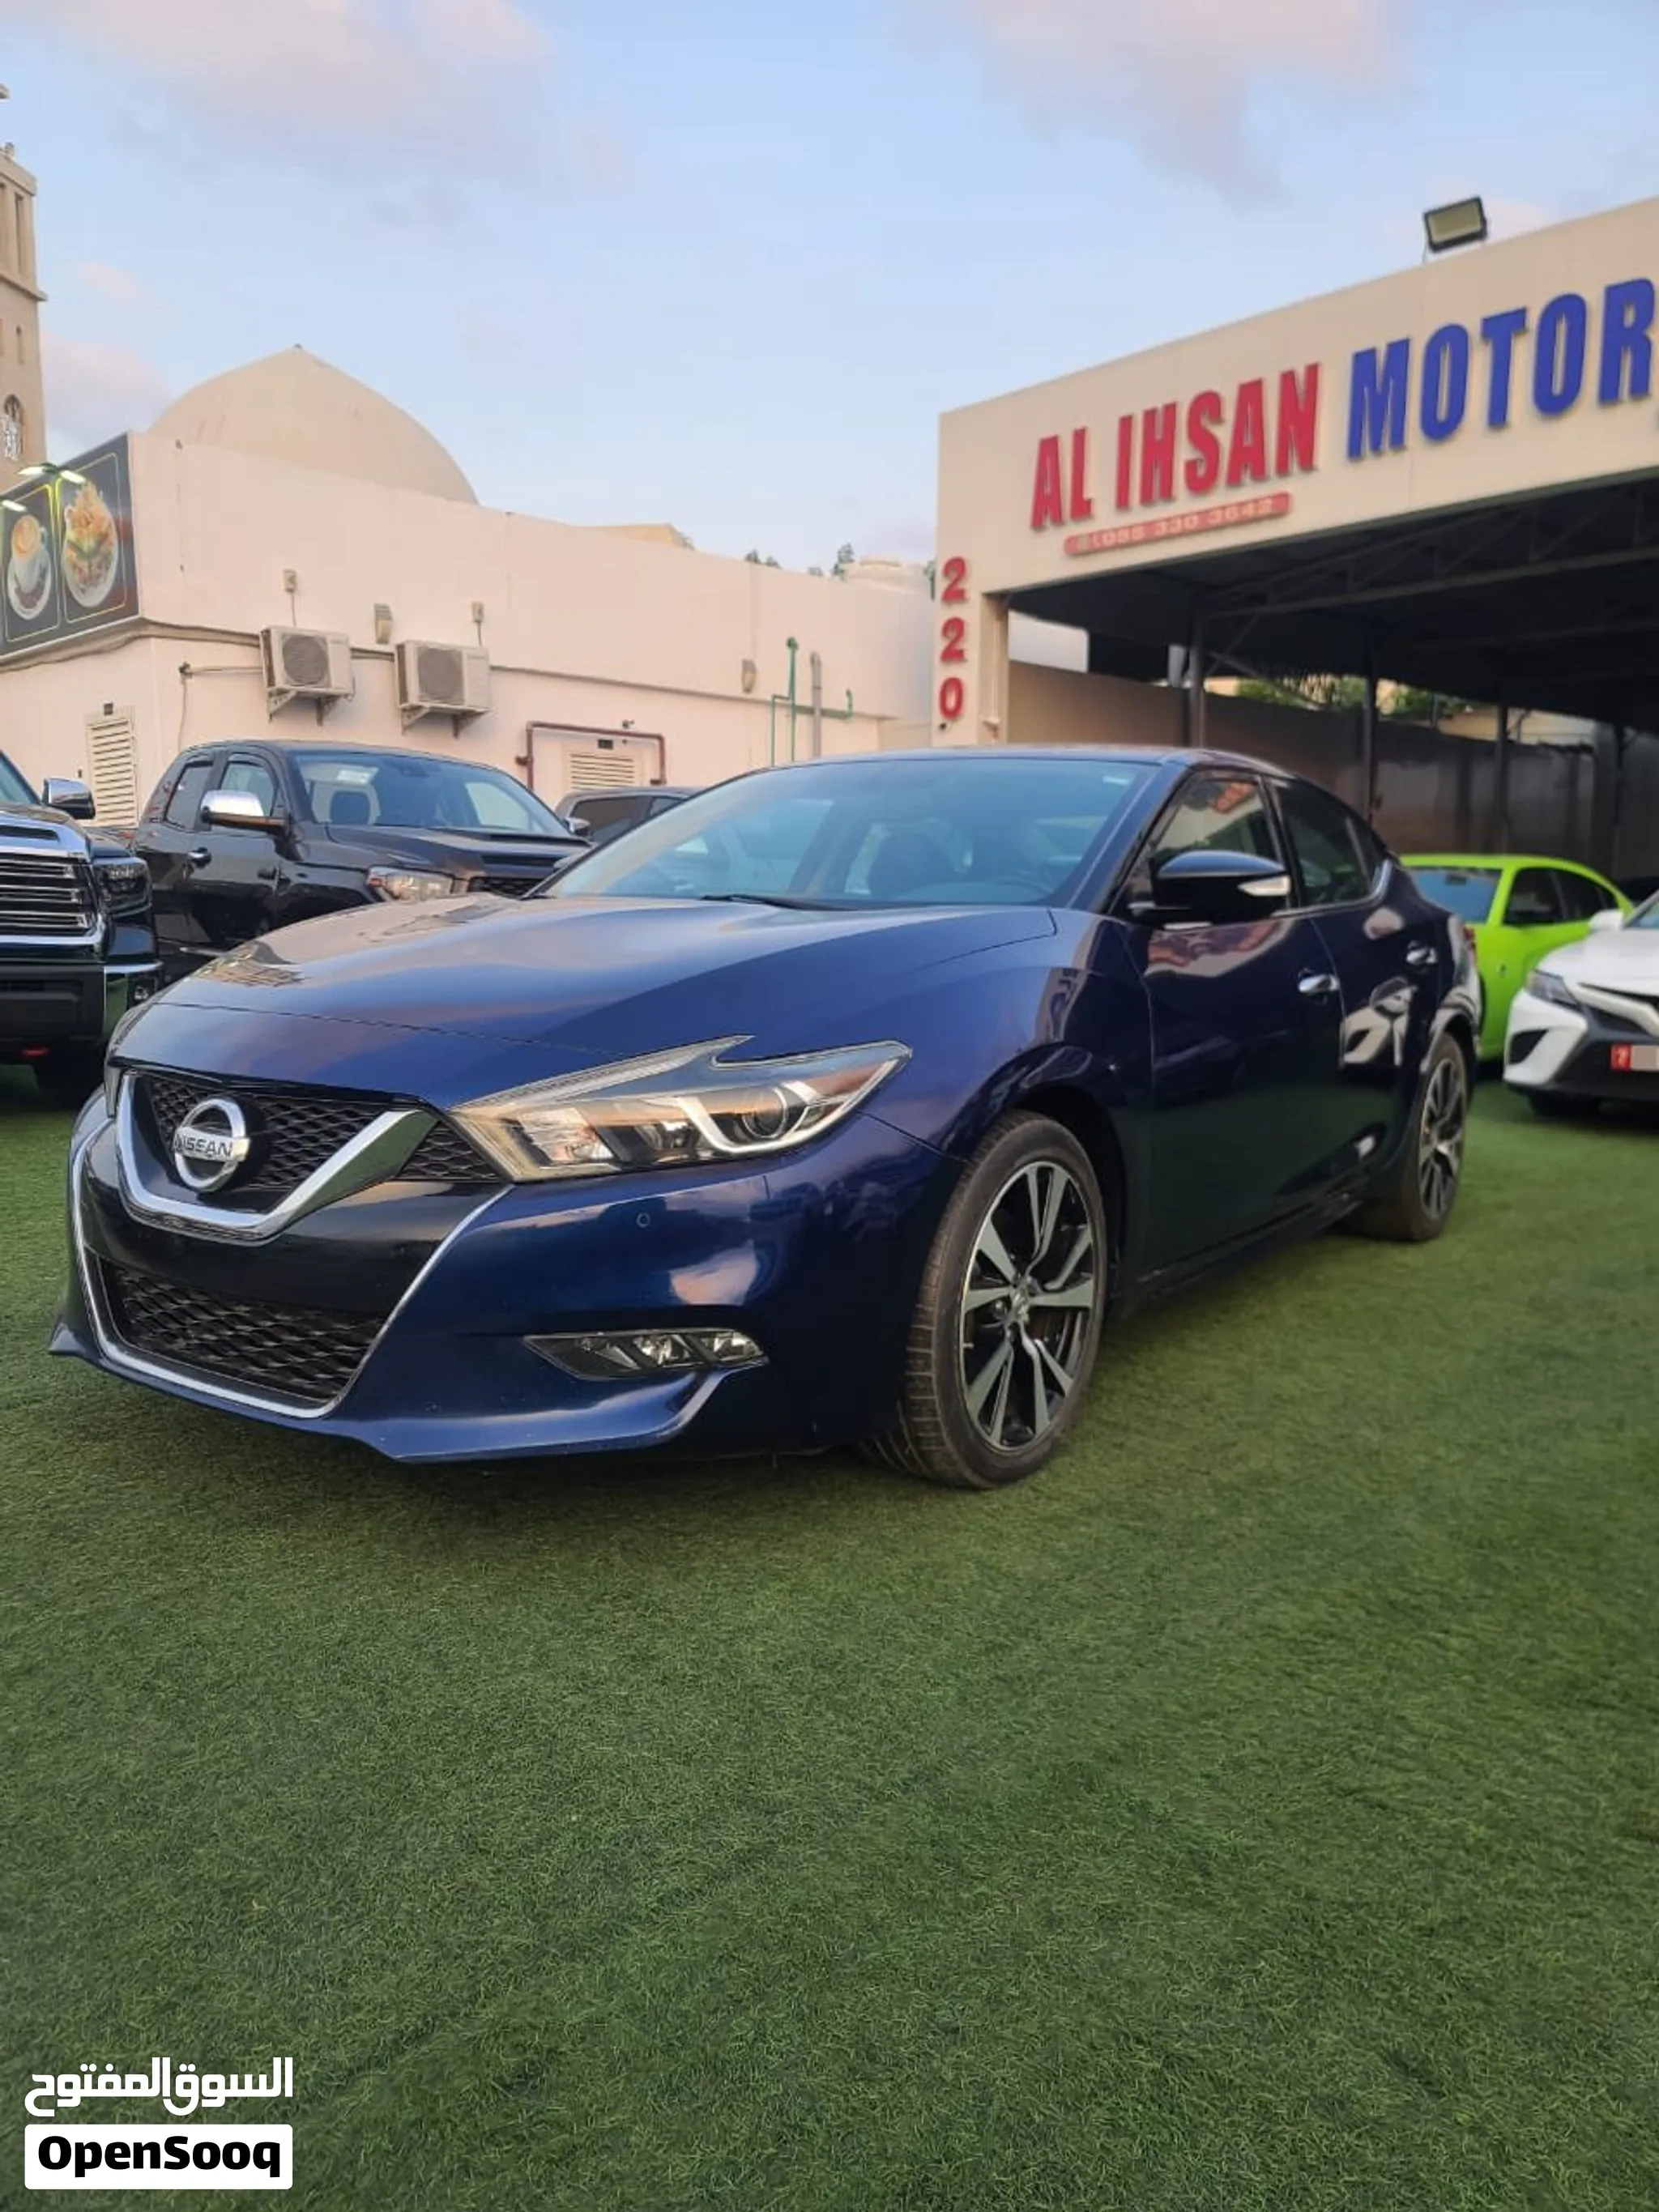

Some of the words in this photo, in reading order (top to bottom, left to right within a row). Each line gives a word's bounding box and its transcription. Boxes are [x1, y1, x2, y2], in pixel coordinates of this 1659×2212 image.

[1032, 430, 1093, 527] AL
[1115, 364, 1320, 510] IHSAN
[1347, 279, 1655, 458] MOTOR
[940, 556, 966, 719] 220
[174, 1133, 233, 1157] NISSAN
